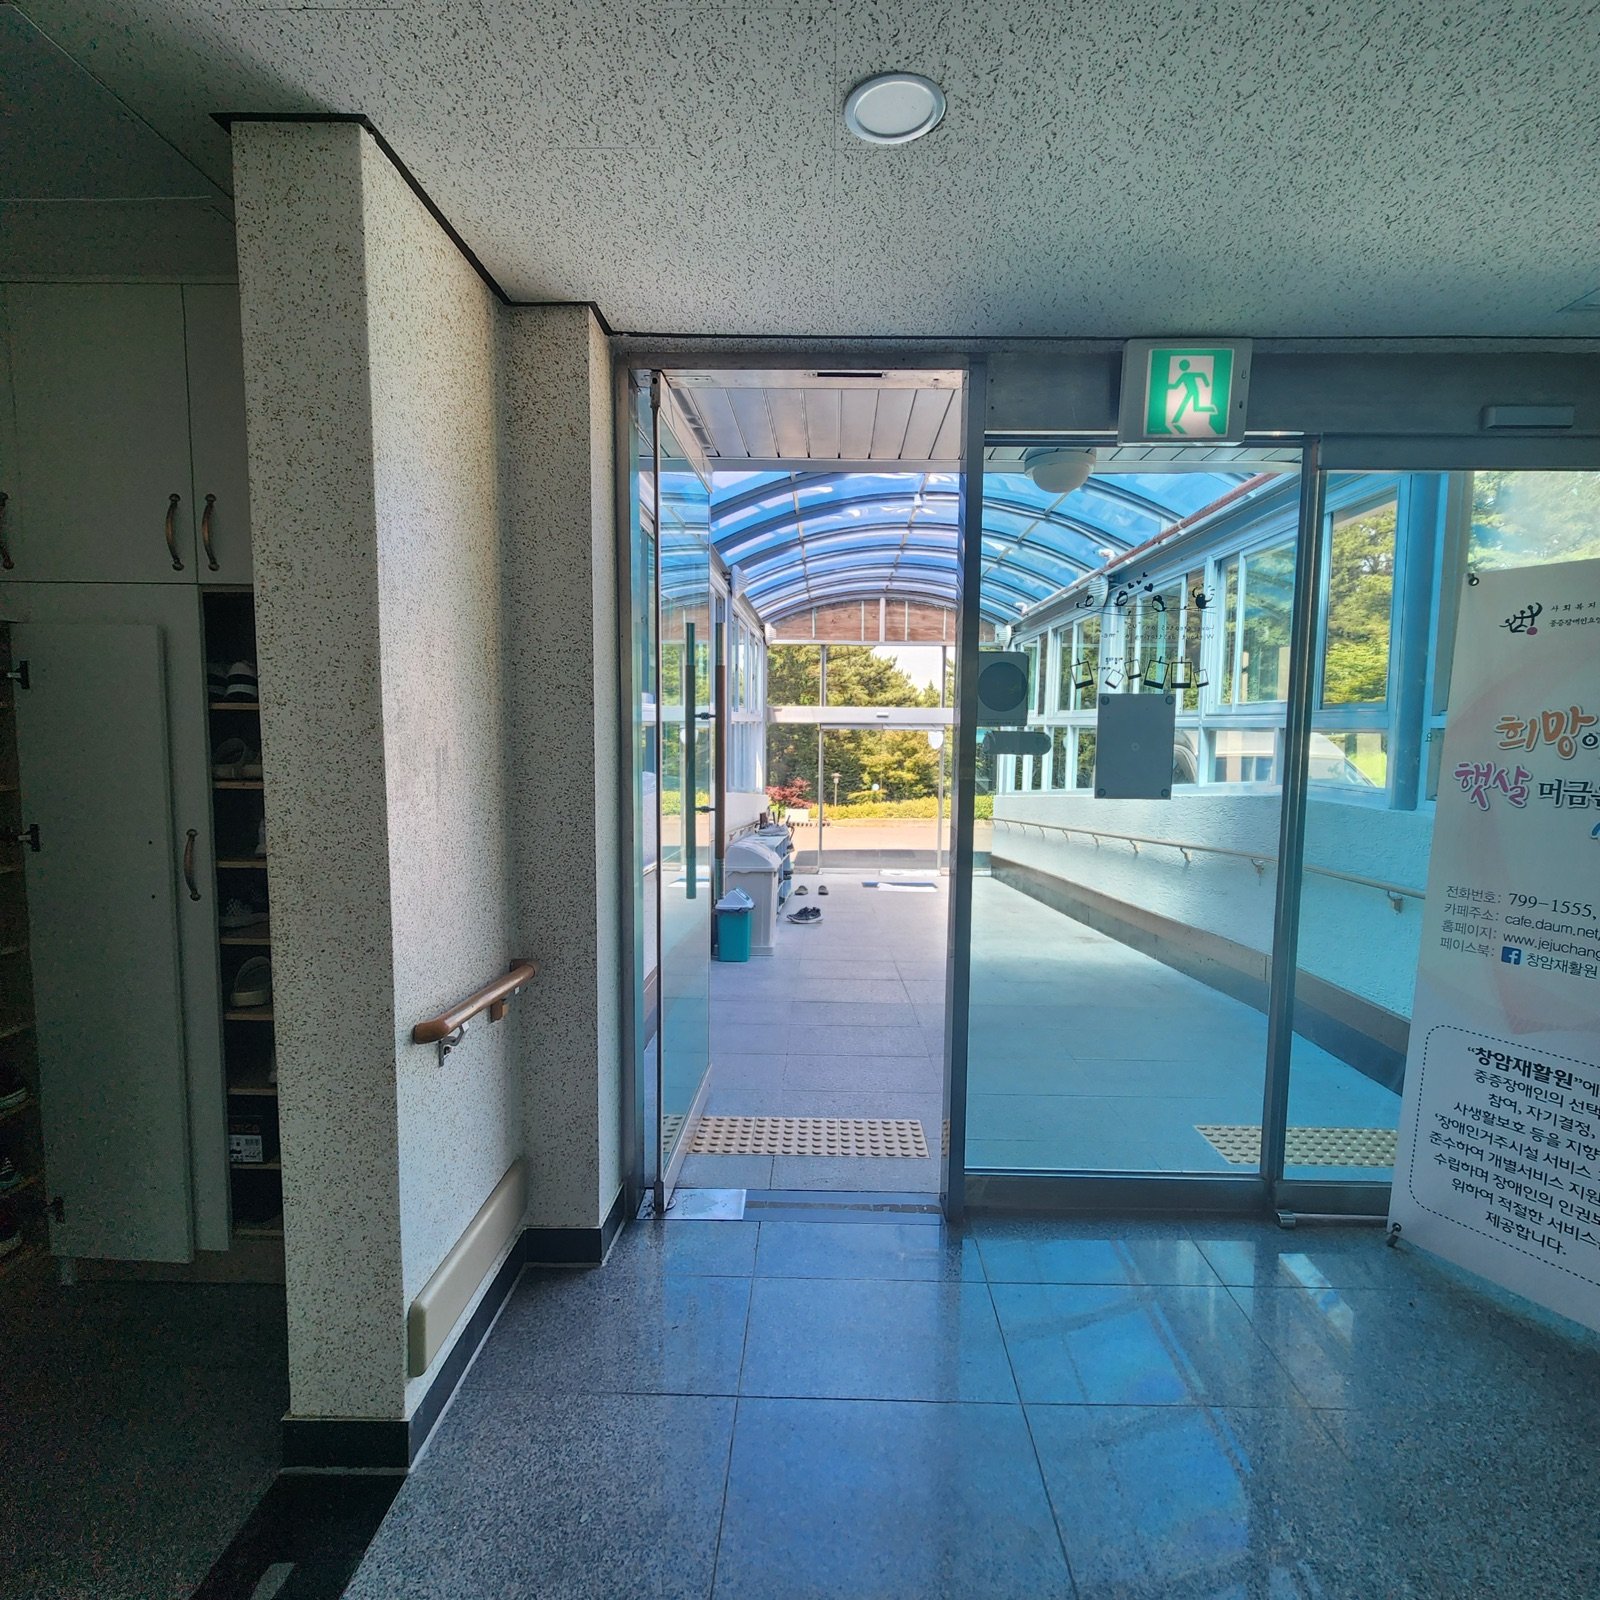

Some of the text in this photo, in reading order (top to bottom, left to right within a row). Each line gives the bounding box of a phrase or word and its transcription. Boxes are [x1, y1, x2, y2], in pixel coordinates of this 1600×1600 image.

[1454, 762, 1531, 809] 햇살
[1526, 952, 1598, 980] 창암재활원
[1474, 1069, 1564, 1109] 중증장애인의
[1453, 1101, 1526, 1135] 사생활보호
[1529, 1126, 1561, 1149] 등을
[1488, 1093, 1596, 1140] 참여, 자기결정,
[1429, 1130, 1484, 1162] 준수하여
[1487, 1152, 1565, 1190] 개별서비스
[1433, 1153, 1489, 1184] 수립하며
[1493, 1173, 1554, 1209] 장애인의
[1542, 1152, 1593, 1180] 서비스
[1451, 1177, 1600, 1251] 위하여 적절한 서비스
[1485, 1210, 1567, 1255] 제공합니다.
